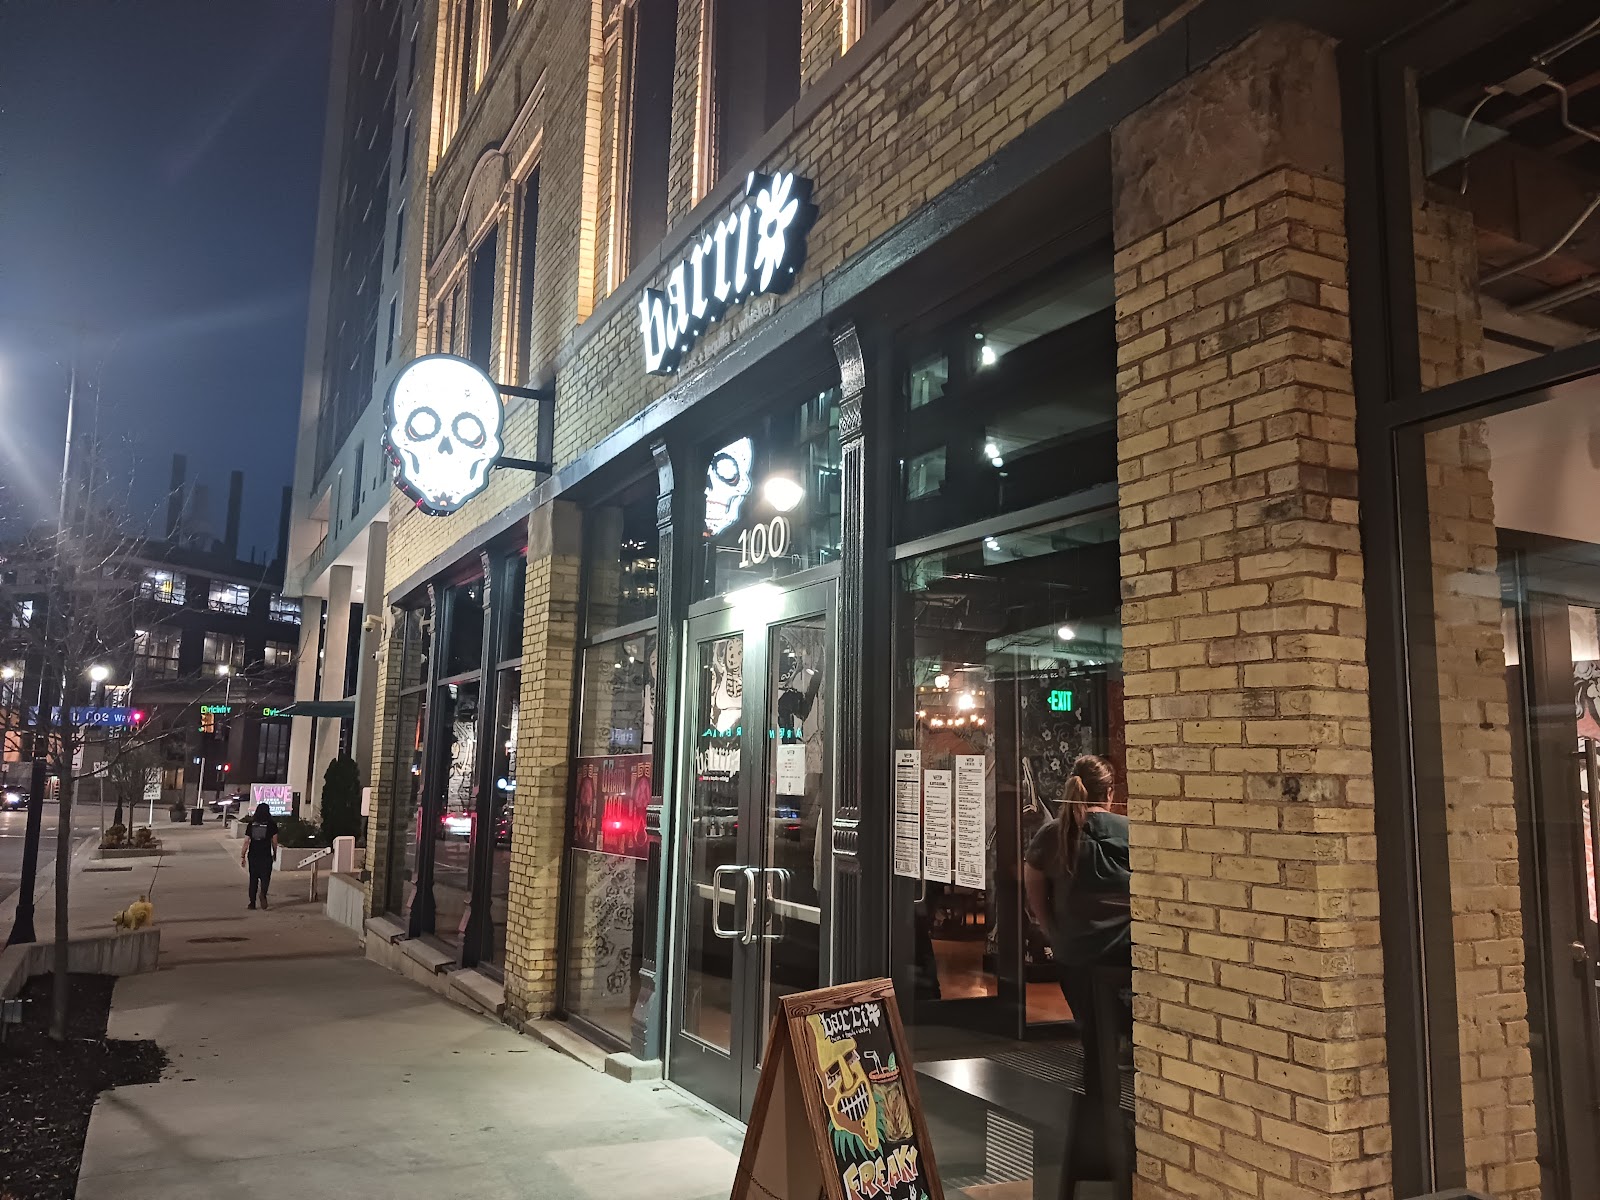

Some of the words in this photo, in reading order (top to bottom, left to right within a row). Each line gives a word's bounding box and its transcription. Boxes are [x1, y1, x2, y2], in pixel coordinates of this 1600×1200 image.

[739, 298, 775, 334] whiskey
[738, 516, 785, 569] 100
[1051, 690, 1073, 711] EXIT
[86, 711, 109, 722] Coe
[114, 714, 131, 723] Way
[254, 785, 292, 803] VENUE
[843, 1144, 919, 1200] FREAKY
